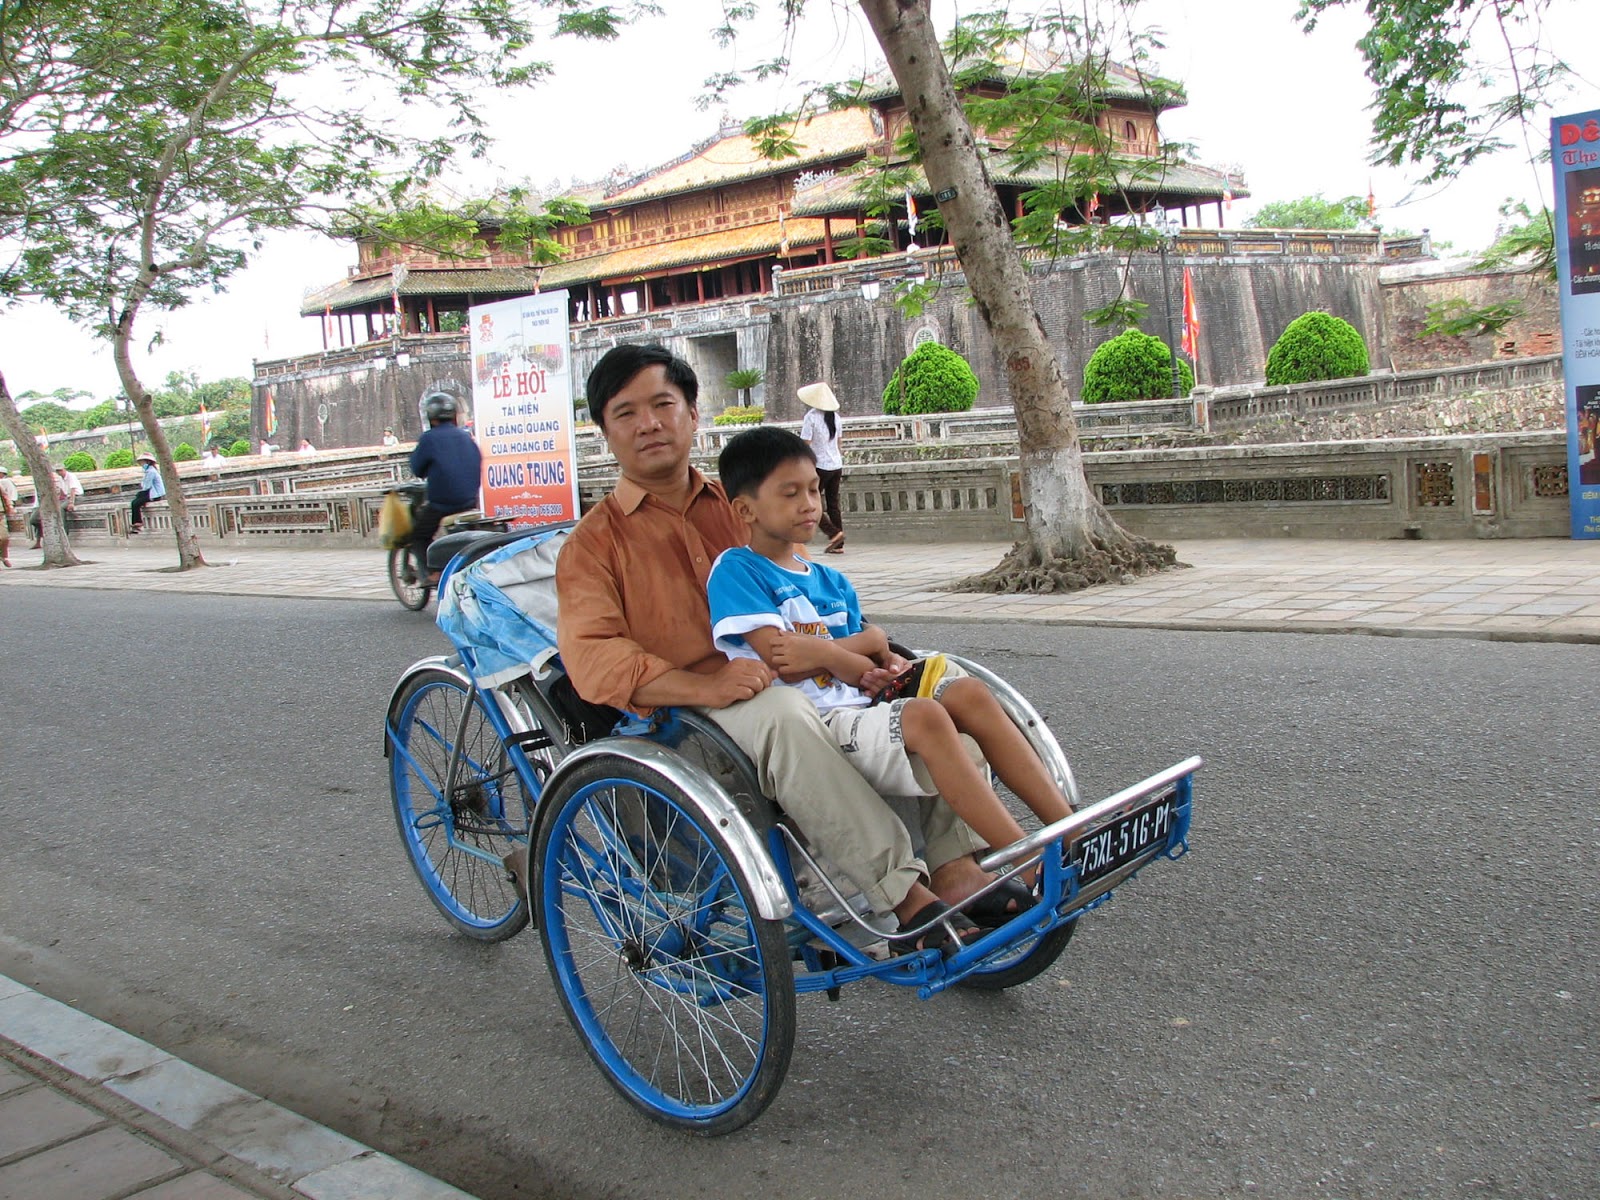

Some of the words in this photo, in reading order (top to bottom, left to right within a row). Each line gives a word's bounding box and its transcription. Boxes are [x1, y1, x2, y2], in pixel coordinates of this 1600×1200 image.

[1562, 149, 1598, 167] The
[492, 362, 512, 399] LỄ
[516, 364, 547, 401] HỘI
[518, 402, 539, 418] HIỆN
[526, 420, 560, 434] QUANG
[487, 463, 525, 488] QUANG
[526, 460, 565, 485] TRUNG
